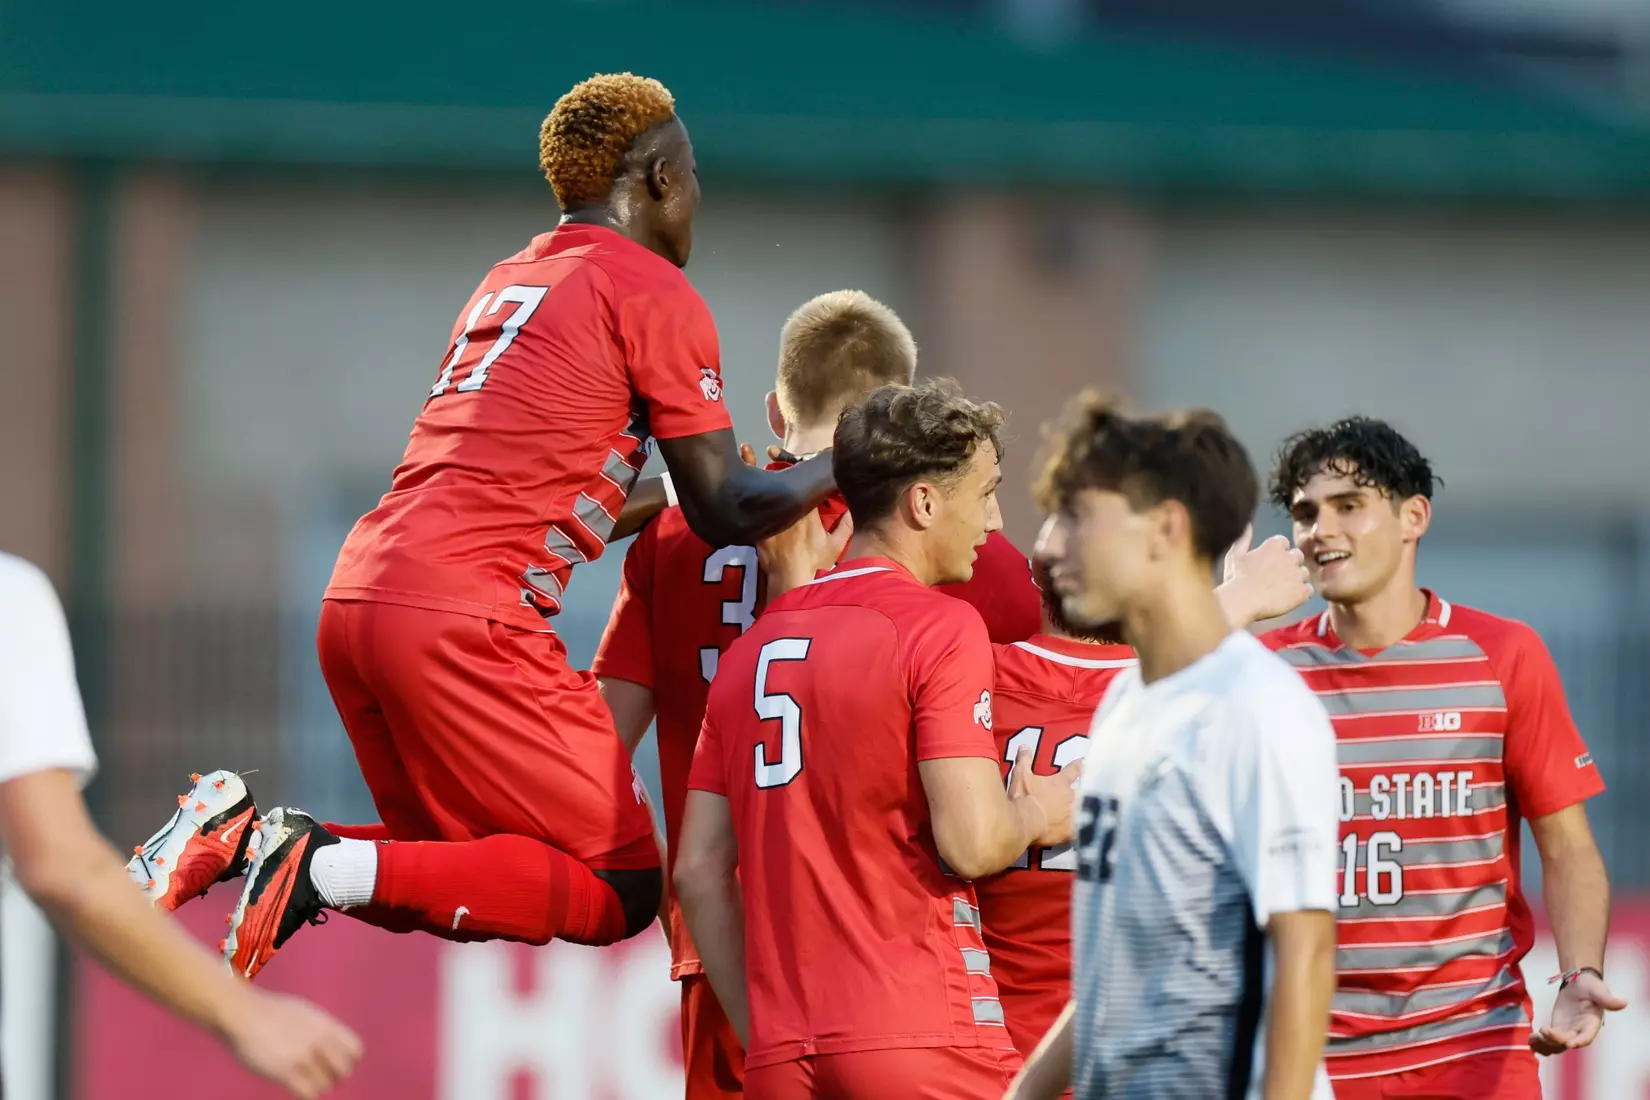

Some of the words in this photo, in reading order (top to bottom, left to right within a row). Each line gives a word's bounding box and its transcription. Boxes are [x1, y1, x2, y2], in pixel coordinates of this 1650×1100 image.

[427, 284, 550, 399] 17
[753, 637, 813, 790] 5
[1369, 771, 1474, 820] STATE
[1339, 831, 1404, 907] 16
